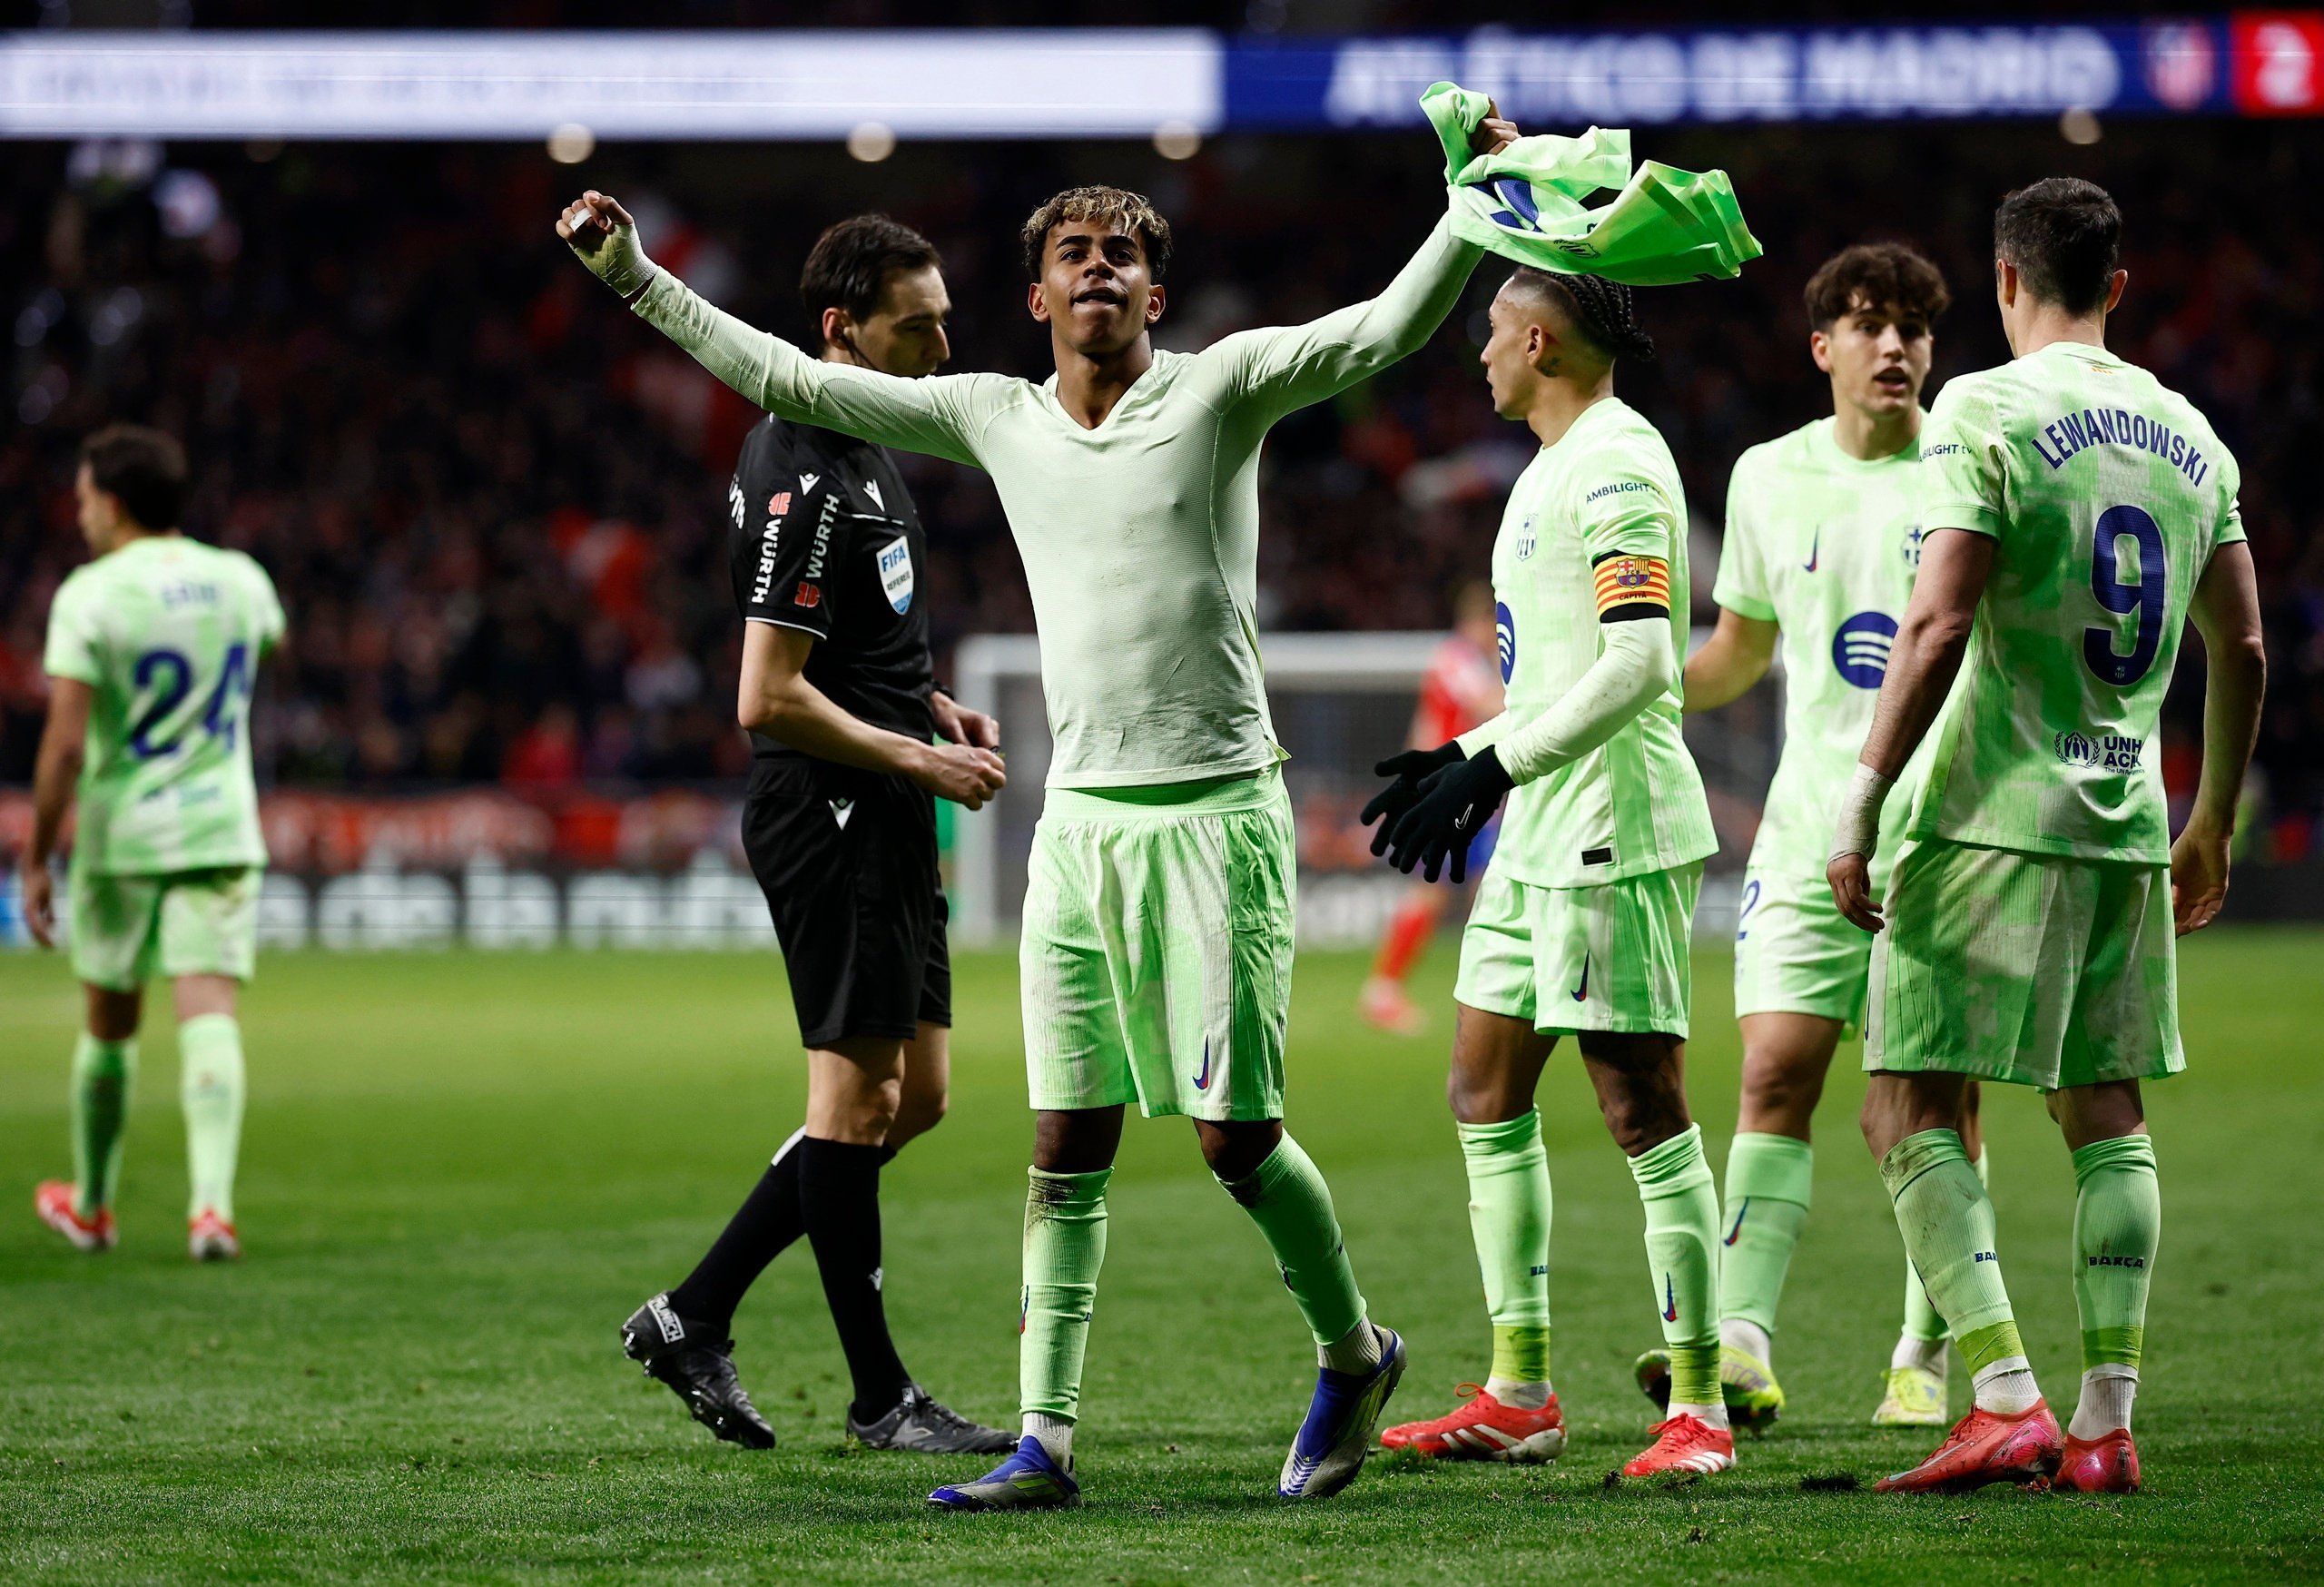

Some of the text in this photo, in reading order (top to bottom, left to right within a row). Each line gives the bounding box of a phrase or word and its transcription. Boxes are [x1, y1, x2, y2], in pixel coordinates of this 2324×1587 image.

[2031, 408, 2208, 488] LEWANDOWSKI
[1586, 482, 1649, 505] AMBILIGHT
[751, 518, 782, 604] WÜRTH
[806, 493, 840, 578] WÜRTH
[881, 545, 906, 573] FIFA
[2083, 504, 2165, 686] 9
[130, 644, 250, 761] 24
[2089, 1256, 2144, 1268] BARÇA
